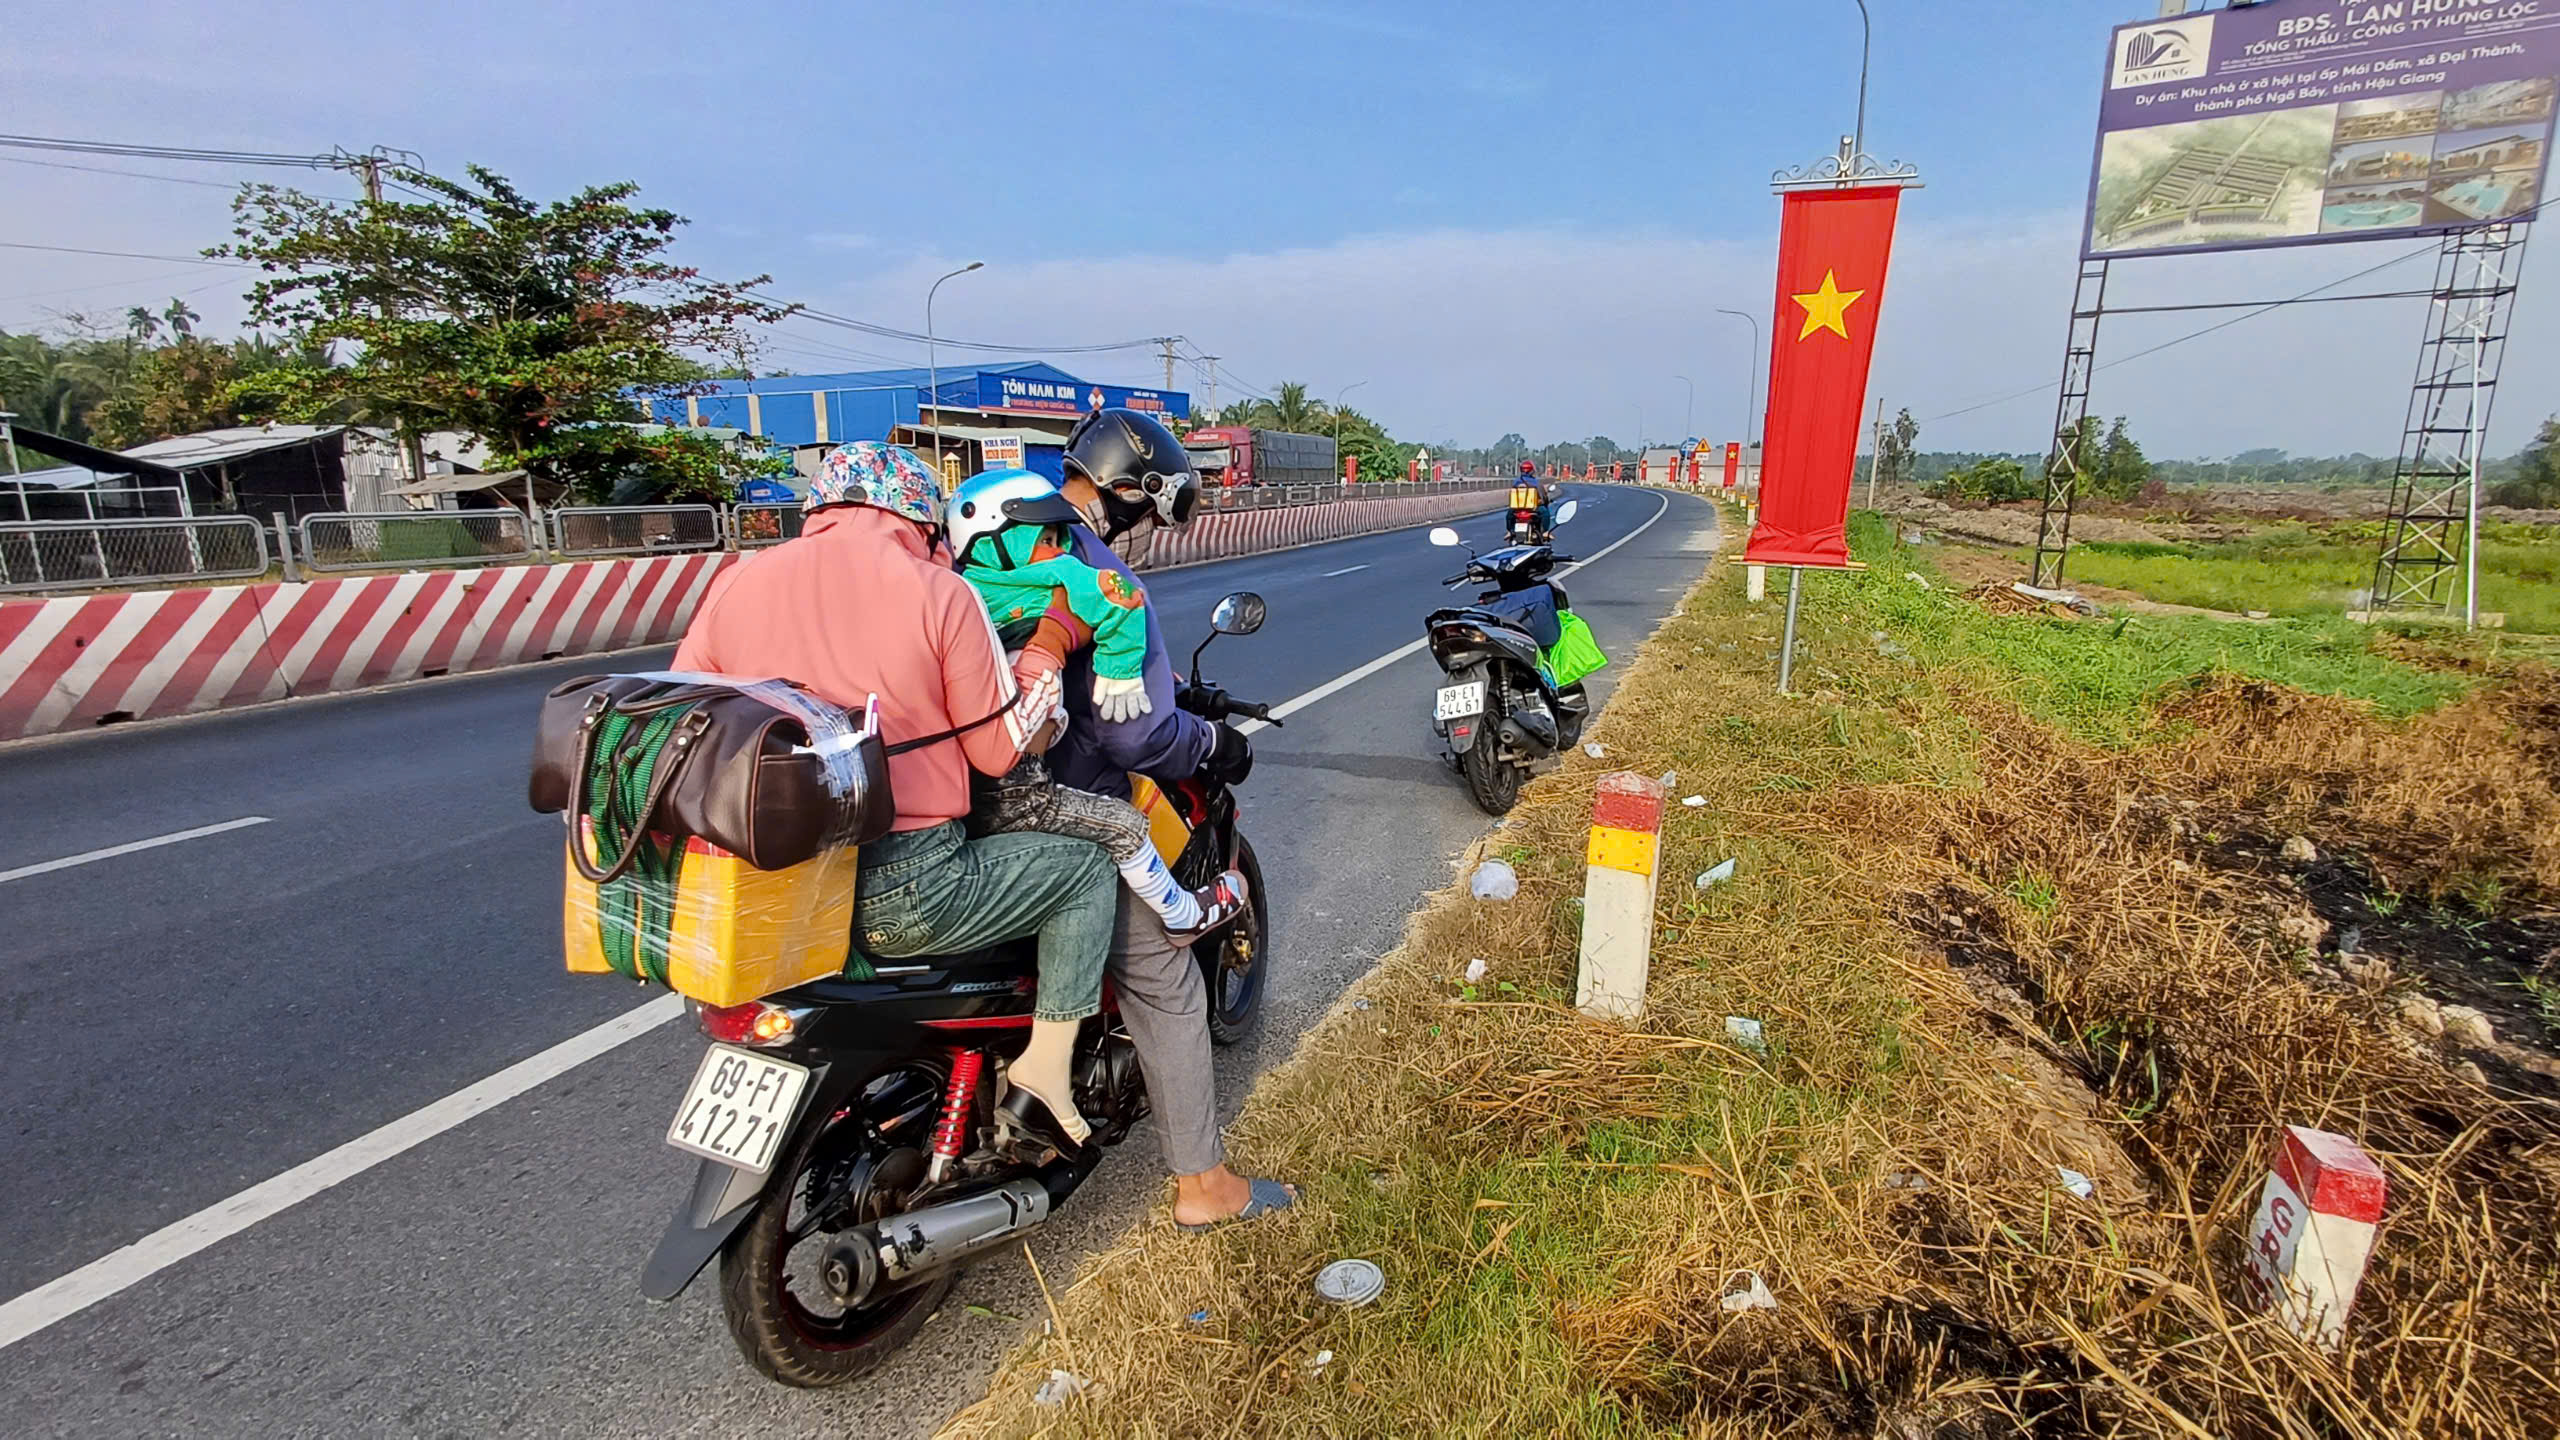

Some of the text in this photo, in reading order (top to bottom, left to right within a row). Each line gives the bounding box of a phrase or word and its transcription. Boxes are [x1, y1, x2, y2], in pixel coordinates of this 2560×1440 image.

[2277, 12, 2337, 37] BĐS.
[2345, 1, 2403, 26] LAN
[2351, 24, 2406, 40] CÔNG
[2410, 18, 2433, 31] TY
[2436, 9, 2493, 27] HƯNG
[2497, 2, 2539, 20] LỘC
[2135, 94, 2155, 106] Dự
[2157, 91, 2178, 102] án:
[2181, 87, 2207, 99] Khu
[2209, 82, 2235, 95] nhà
[2252, 77, 2269, 88] xã
[2271, 72, 2294, 88] hội
[2297, 70, 2317, 84] tại
[2319, 67, 2339, 81] ấp
[2342, 63, 2370, 77] Mái
[2416, 54, 2436, 67] xã
[2439, 49, 2467, 65] Đại
[2194, 98, 2233, 112] thành
[2235, 92, 2264, 108] phố
[2266, 89, 2296, 104] Ngã
[2332, 81, 2361, 94] tỉnh
[2365, 77, 2396, 92] Hậu
[2399, 71, 2447, 85] Giang
[1001, 378, 1076, 400] TÔN NAM KIM
[1439, 698, 1480, 718] 544.61
[1443, 685, 1474, 703] 69-E1
[710, 1055, 789, 1113] 69-F1
[680, 1098, 778, 1165] 412.71
